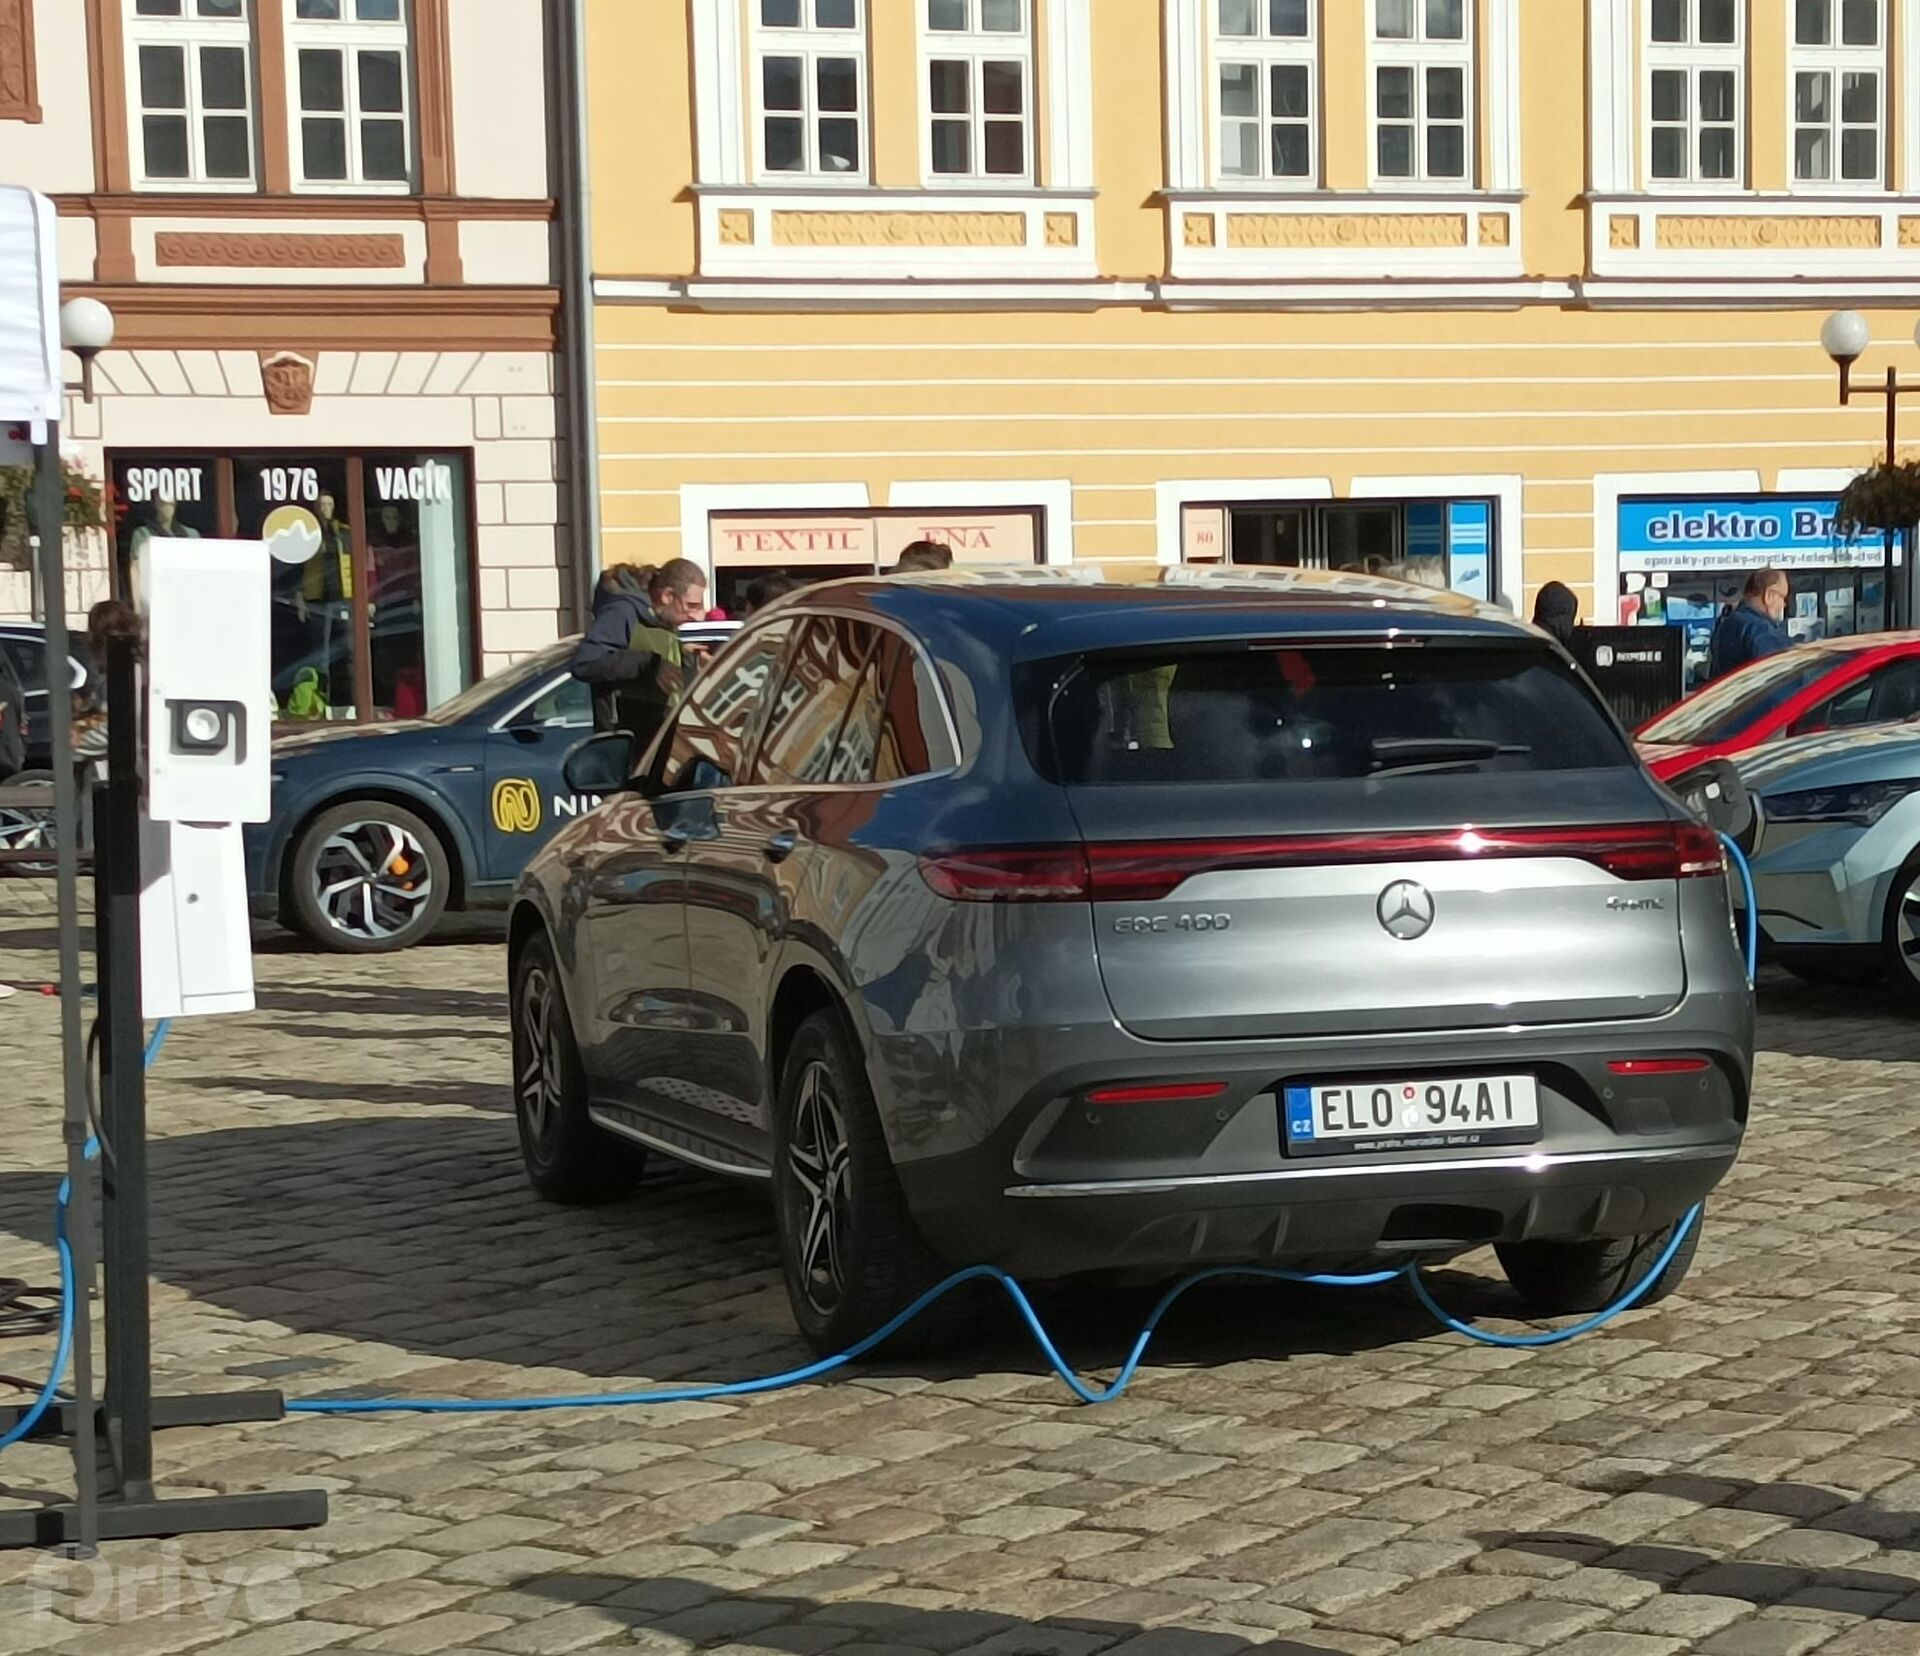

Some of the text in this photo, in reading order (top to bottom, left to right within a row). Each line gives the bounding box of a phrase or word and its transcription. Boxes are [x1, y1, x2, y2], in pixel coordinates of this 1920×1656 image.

[127, 468, 202, 502] SPORT
[260, 468, 318, 501] 1976
[1649, 511, 1778, 539] elektro
[727, 530, 859, 551] TEXTIL
[553, 794, 603, 817] NI
[1175, 912, 1231, 932] 400
[1292, 1120, 1311, 1132] CZ
